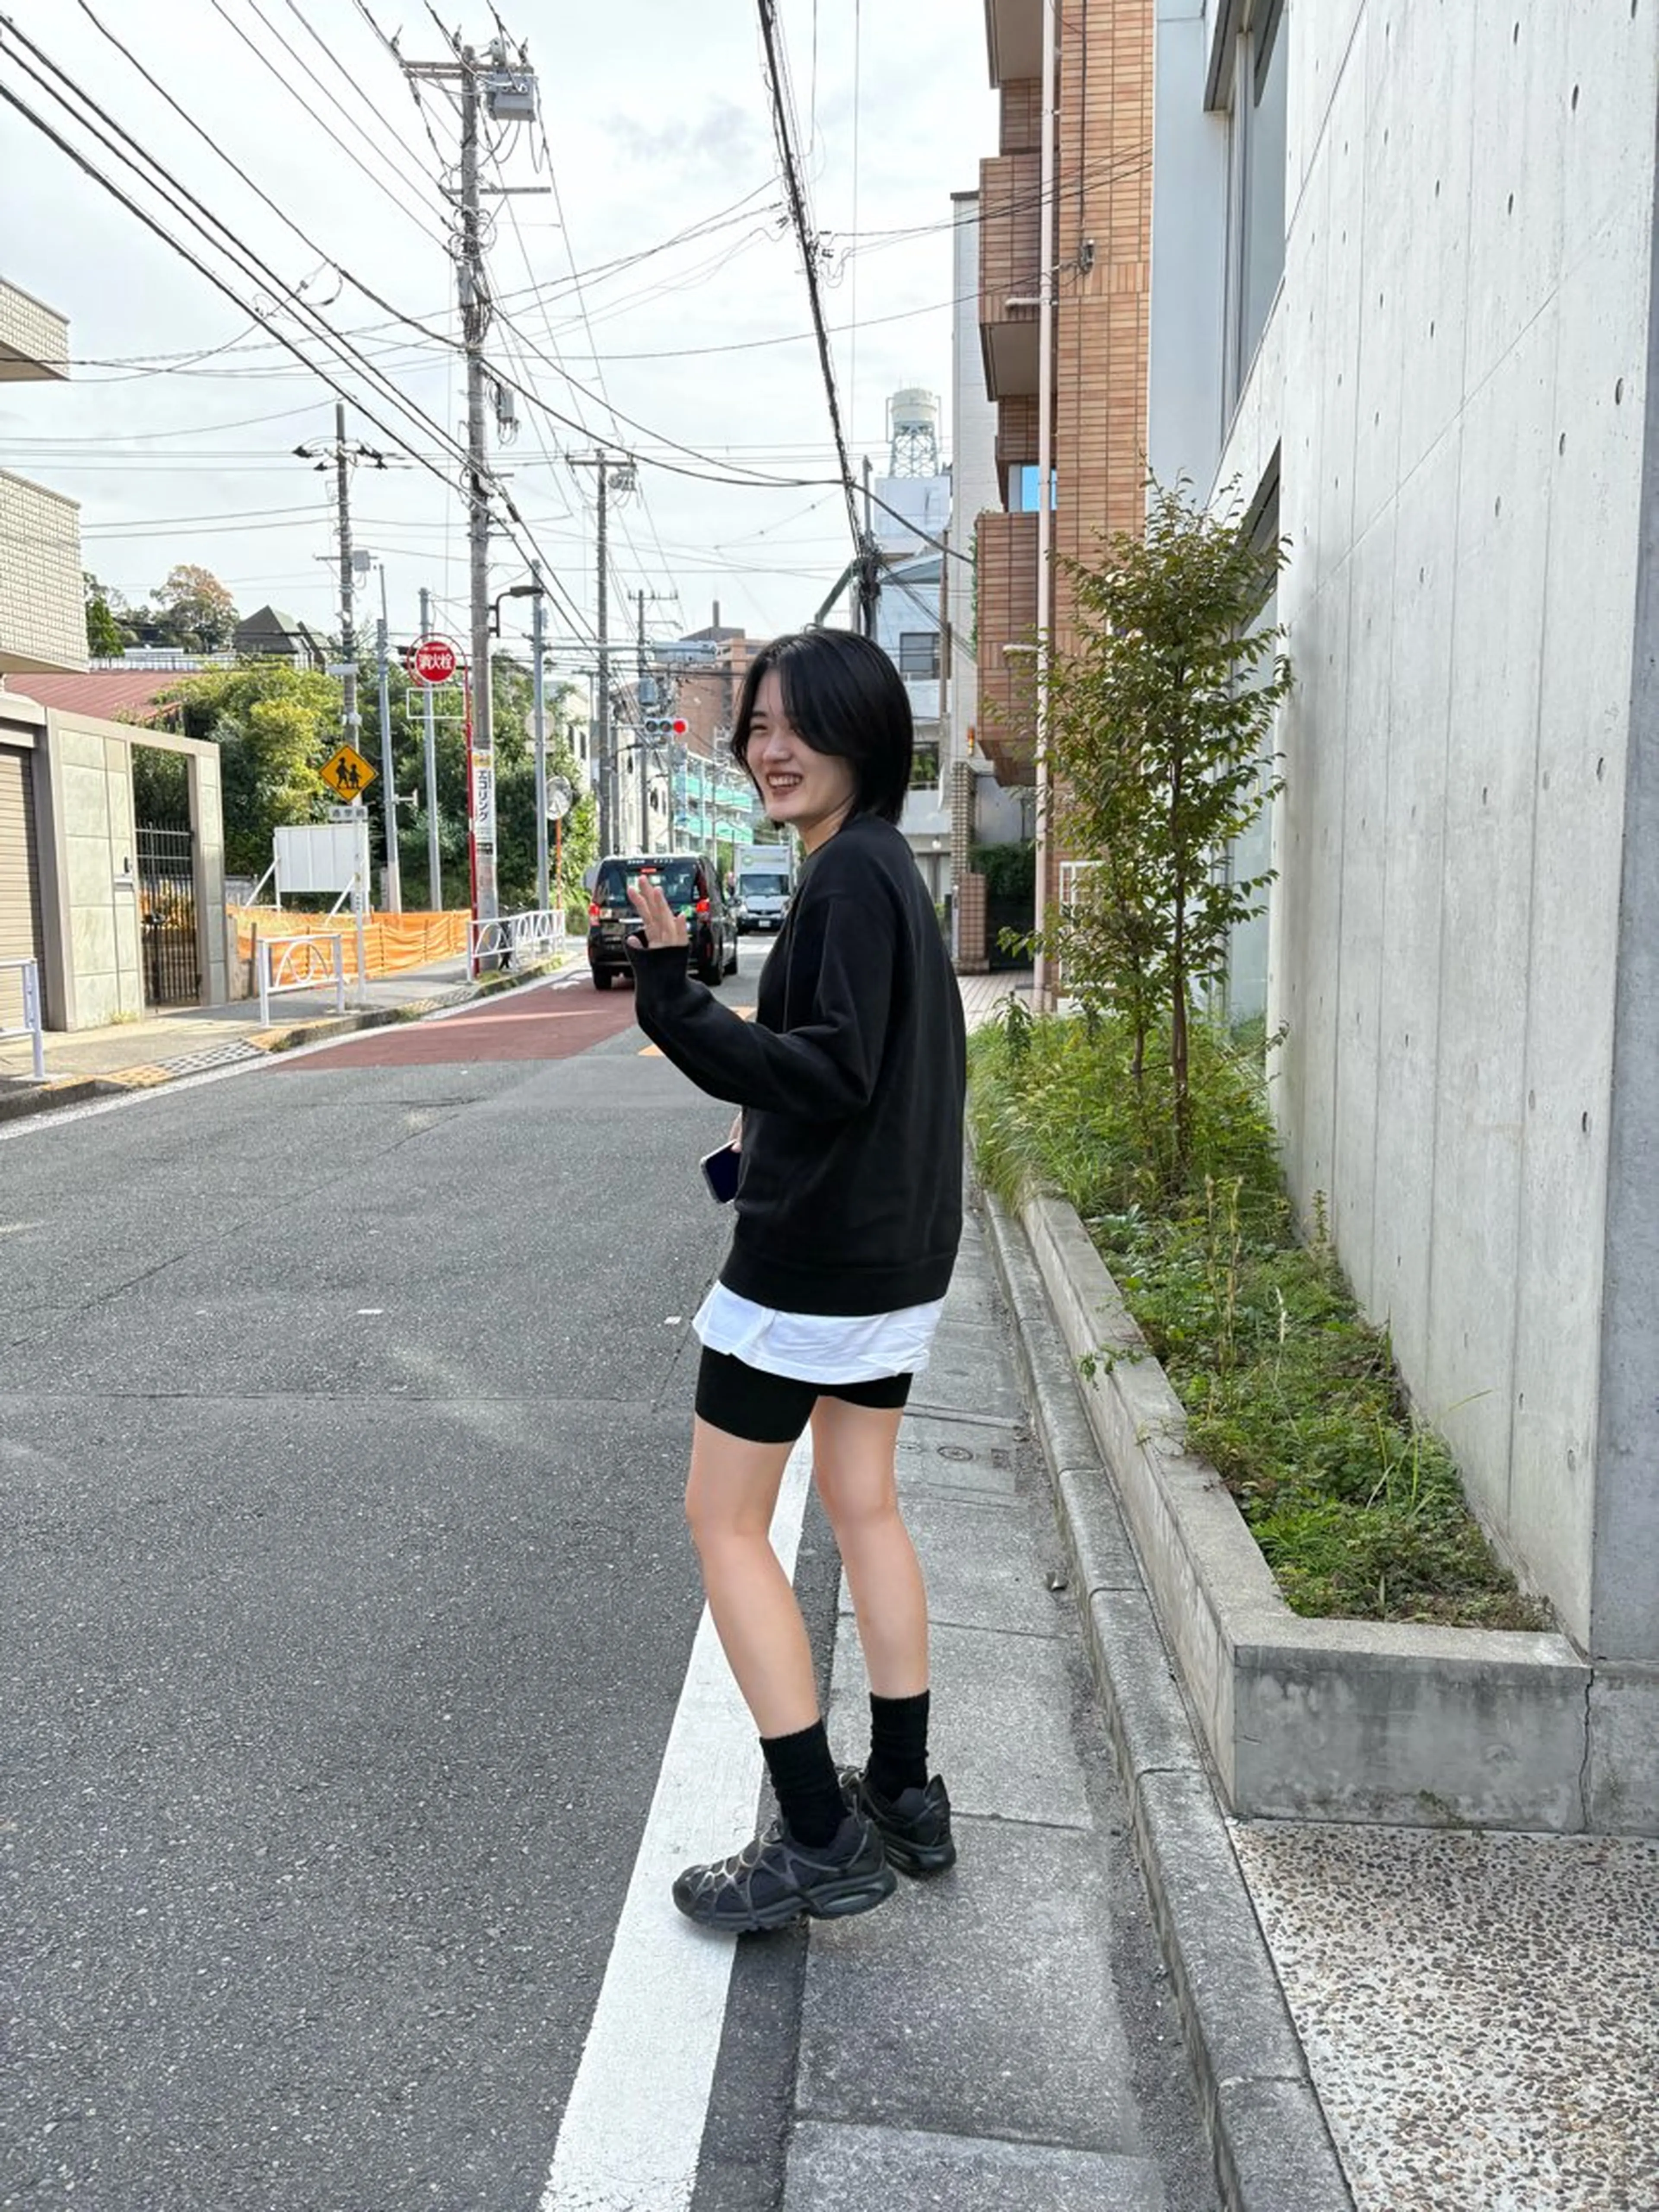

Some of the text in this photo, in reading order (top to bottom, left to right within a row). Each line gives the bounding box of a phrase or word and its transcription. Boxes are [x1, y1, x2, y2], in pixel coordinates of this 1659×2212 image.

[419, 653, 452, 670] 消火栓
[478, 770, 488, 822] エコリング
